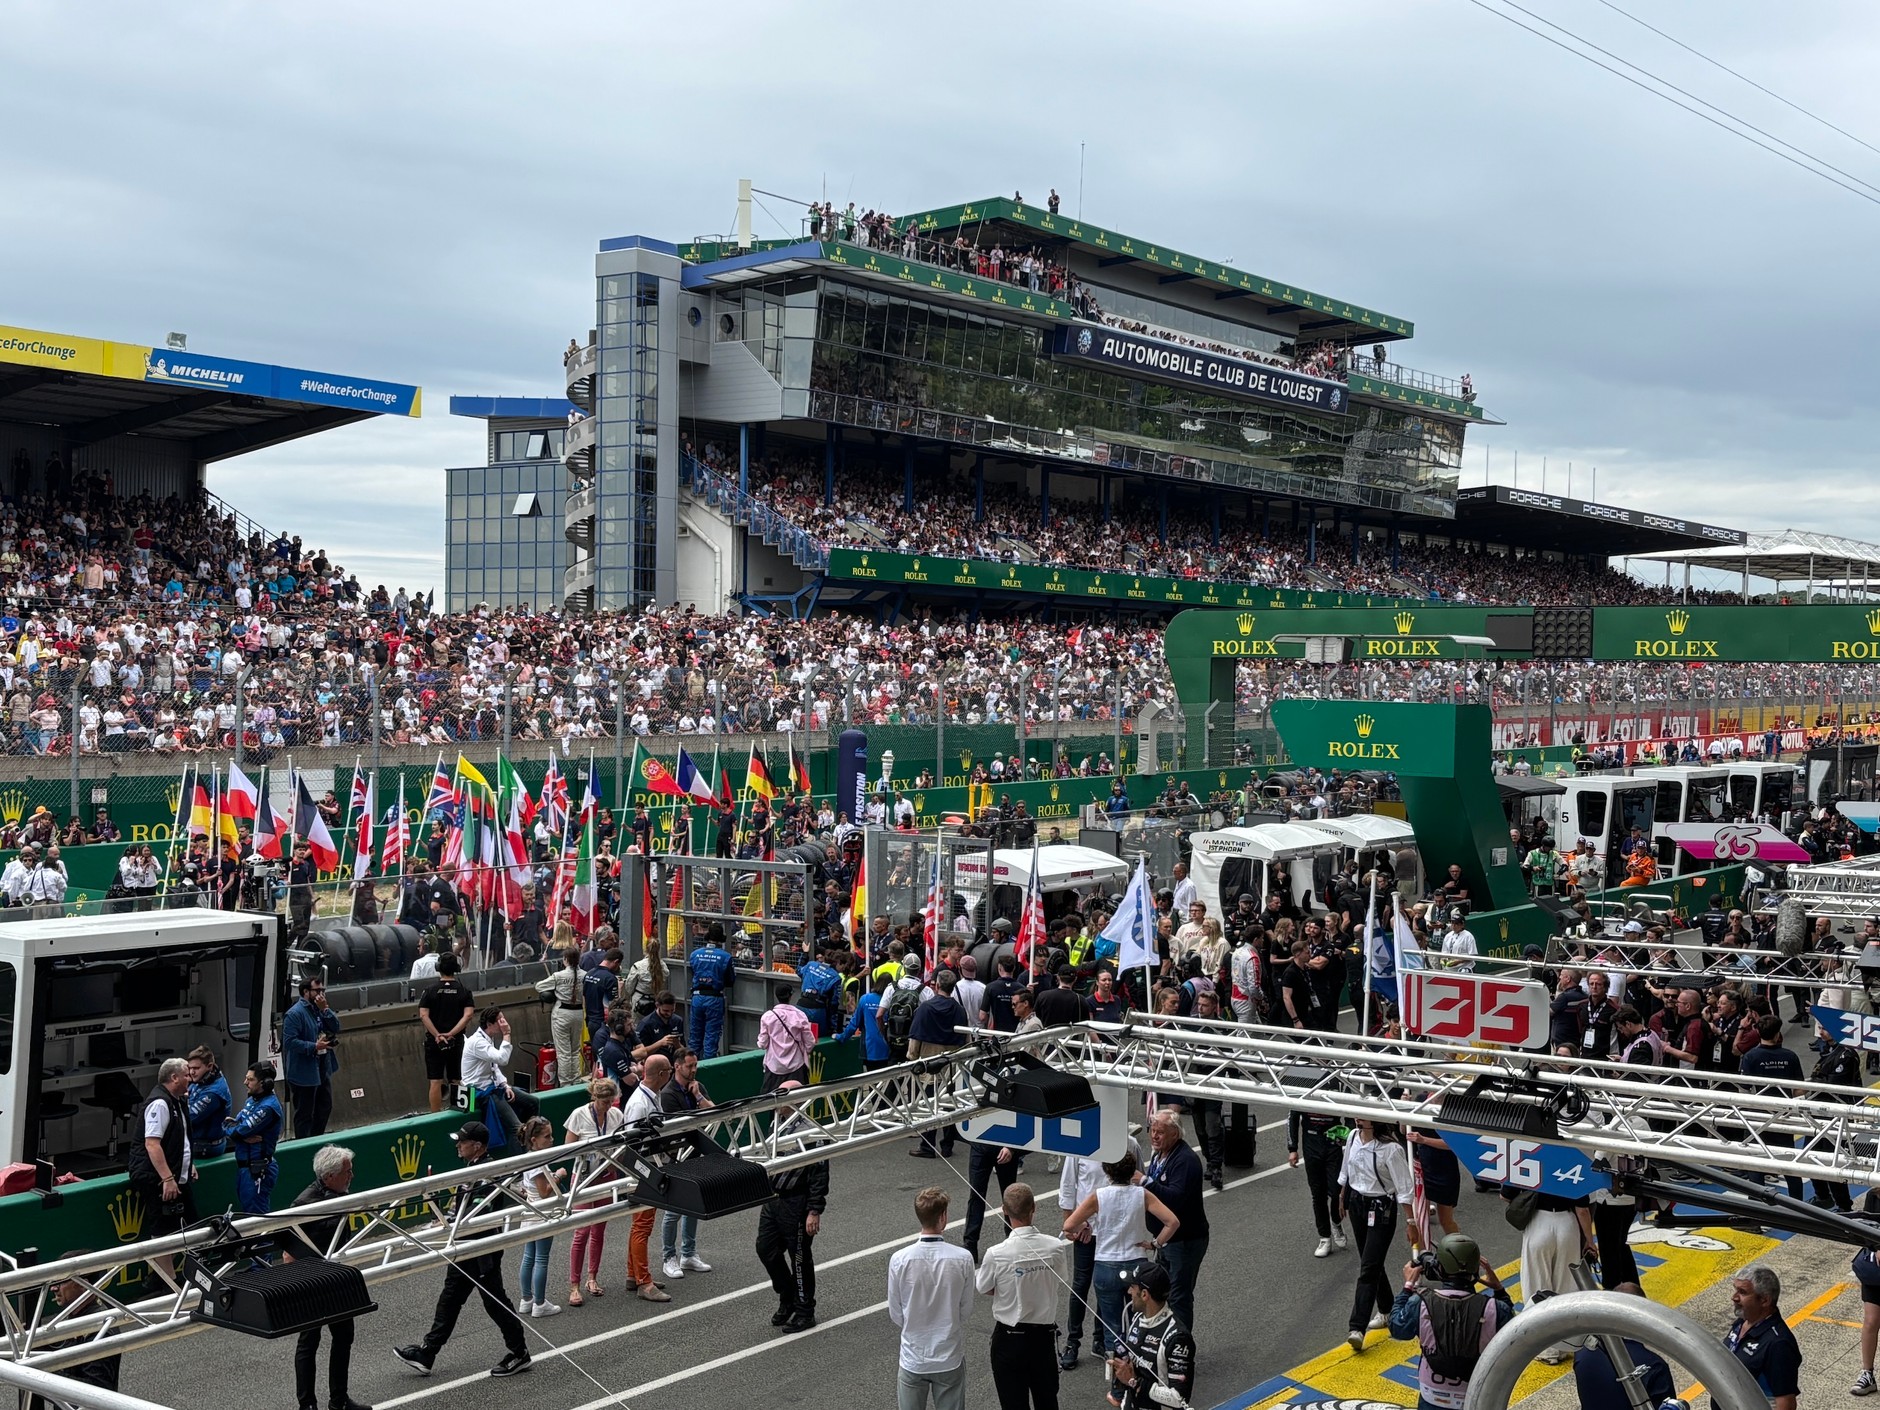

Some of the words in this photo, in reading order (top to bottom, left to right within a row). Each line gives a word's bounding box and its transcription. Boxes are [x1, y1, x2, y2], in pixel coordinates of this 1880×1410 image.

[170, 364, 244, 384] MICHELIN
[1102, 338, 1202, 377] AUTOMOBILE
[1208, 362, 1245, 386] CLUB
[1248, 372, 1267, 391] DE
[1270, 378, 1323, 403] L'OUEST
[301, 379, 397, 404] #WeRaceForChange
[1509, 491, 1562, 509] PORSCHE
[1583, 504, 1629, 521] PORSCHE
[1643, 515, 1686, 532] PORSCHE
[1702, 526, 1740, 542] PORSCHE
[852, 567, 876, 577] ROLEX
[905, 571, 928, 581] ROLEX
[954, 575, 976, 584] ROLEX
[1002, 578, 1022, 588] ROLEX
[1046, 582, 1065, 591] ROLEX
[1088, 585, 1106, 595] ROLEX
[1128, 589, 1146, 598] ROLEX
[1166, 592, 1183, 600] ROLEX
[1202, 595, 1218, 604] ROLEX
[1212, 640, 1278, 655] ROLEX
[1367, 640, 1440, 656] ROLEX
[1635, 640, 1719, 657] ROLEX
[1328, 742, 1400, 760] ROLEX
[1038, 803, 1070, 817] ROLEX
[1561, 812, 1569, 824] 5
[1212, 840, 1251, 848] MANTHEY
[1714, 826, 1760, 859] 85
[457, 1086, 469, 1109] 5
[1476, 1135, 1542, 1188] 36
